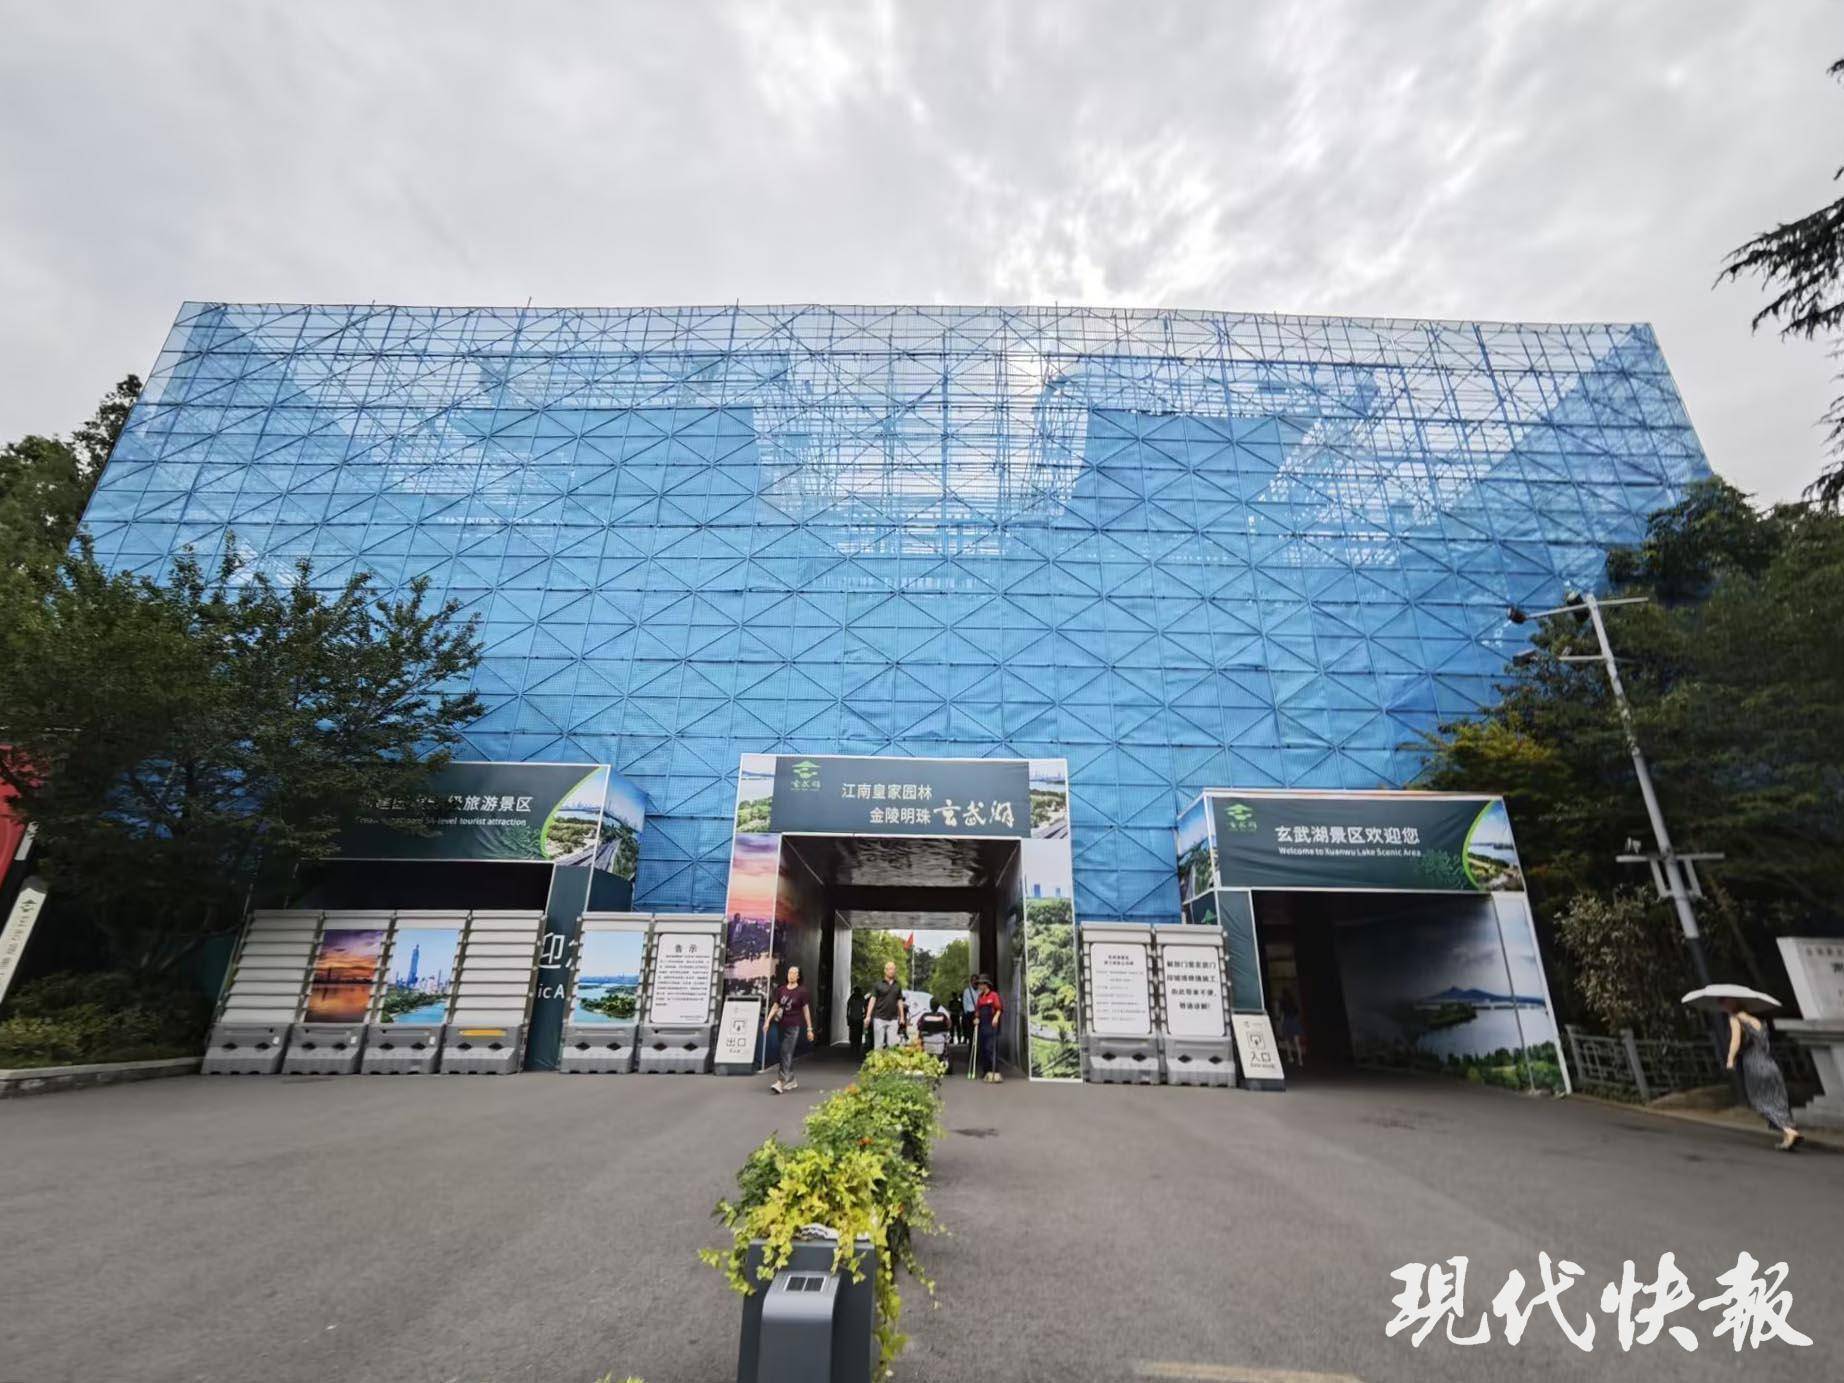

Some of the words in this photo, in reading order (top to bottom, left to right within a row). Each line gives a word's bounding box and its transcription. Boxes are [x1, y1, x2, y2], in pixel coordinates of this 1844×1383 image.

[841, 783, 933, 800] 江南皇家园林
[460, 817, 486, 826] tourist
[487, 817, 527, 827] attraction
[869, 807, 932, 824] 金陵明珠
[1274, 825, 1420, 845] 玄武湖景区欢迎您
[1278, 847, 1314, 856] Welcome
[1315, 848, 1324, 856] to
[1325, 847, 1356, 856] Xuanwu
[1357, 848, 1375, 856] Lake
[1376, 847, 1402, 856] Scenic
[1403, 848, 1422, 857] Area
[1250, 1051, 1272, 1063] 入口
